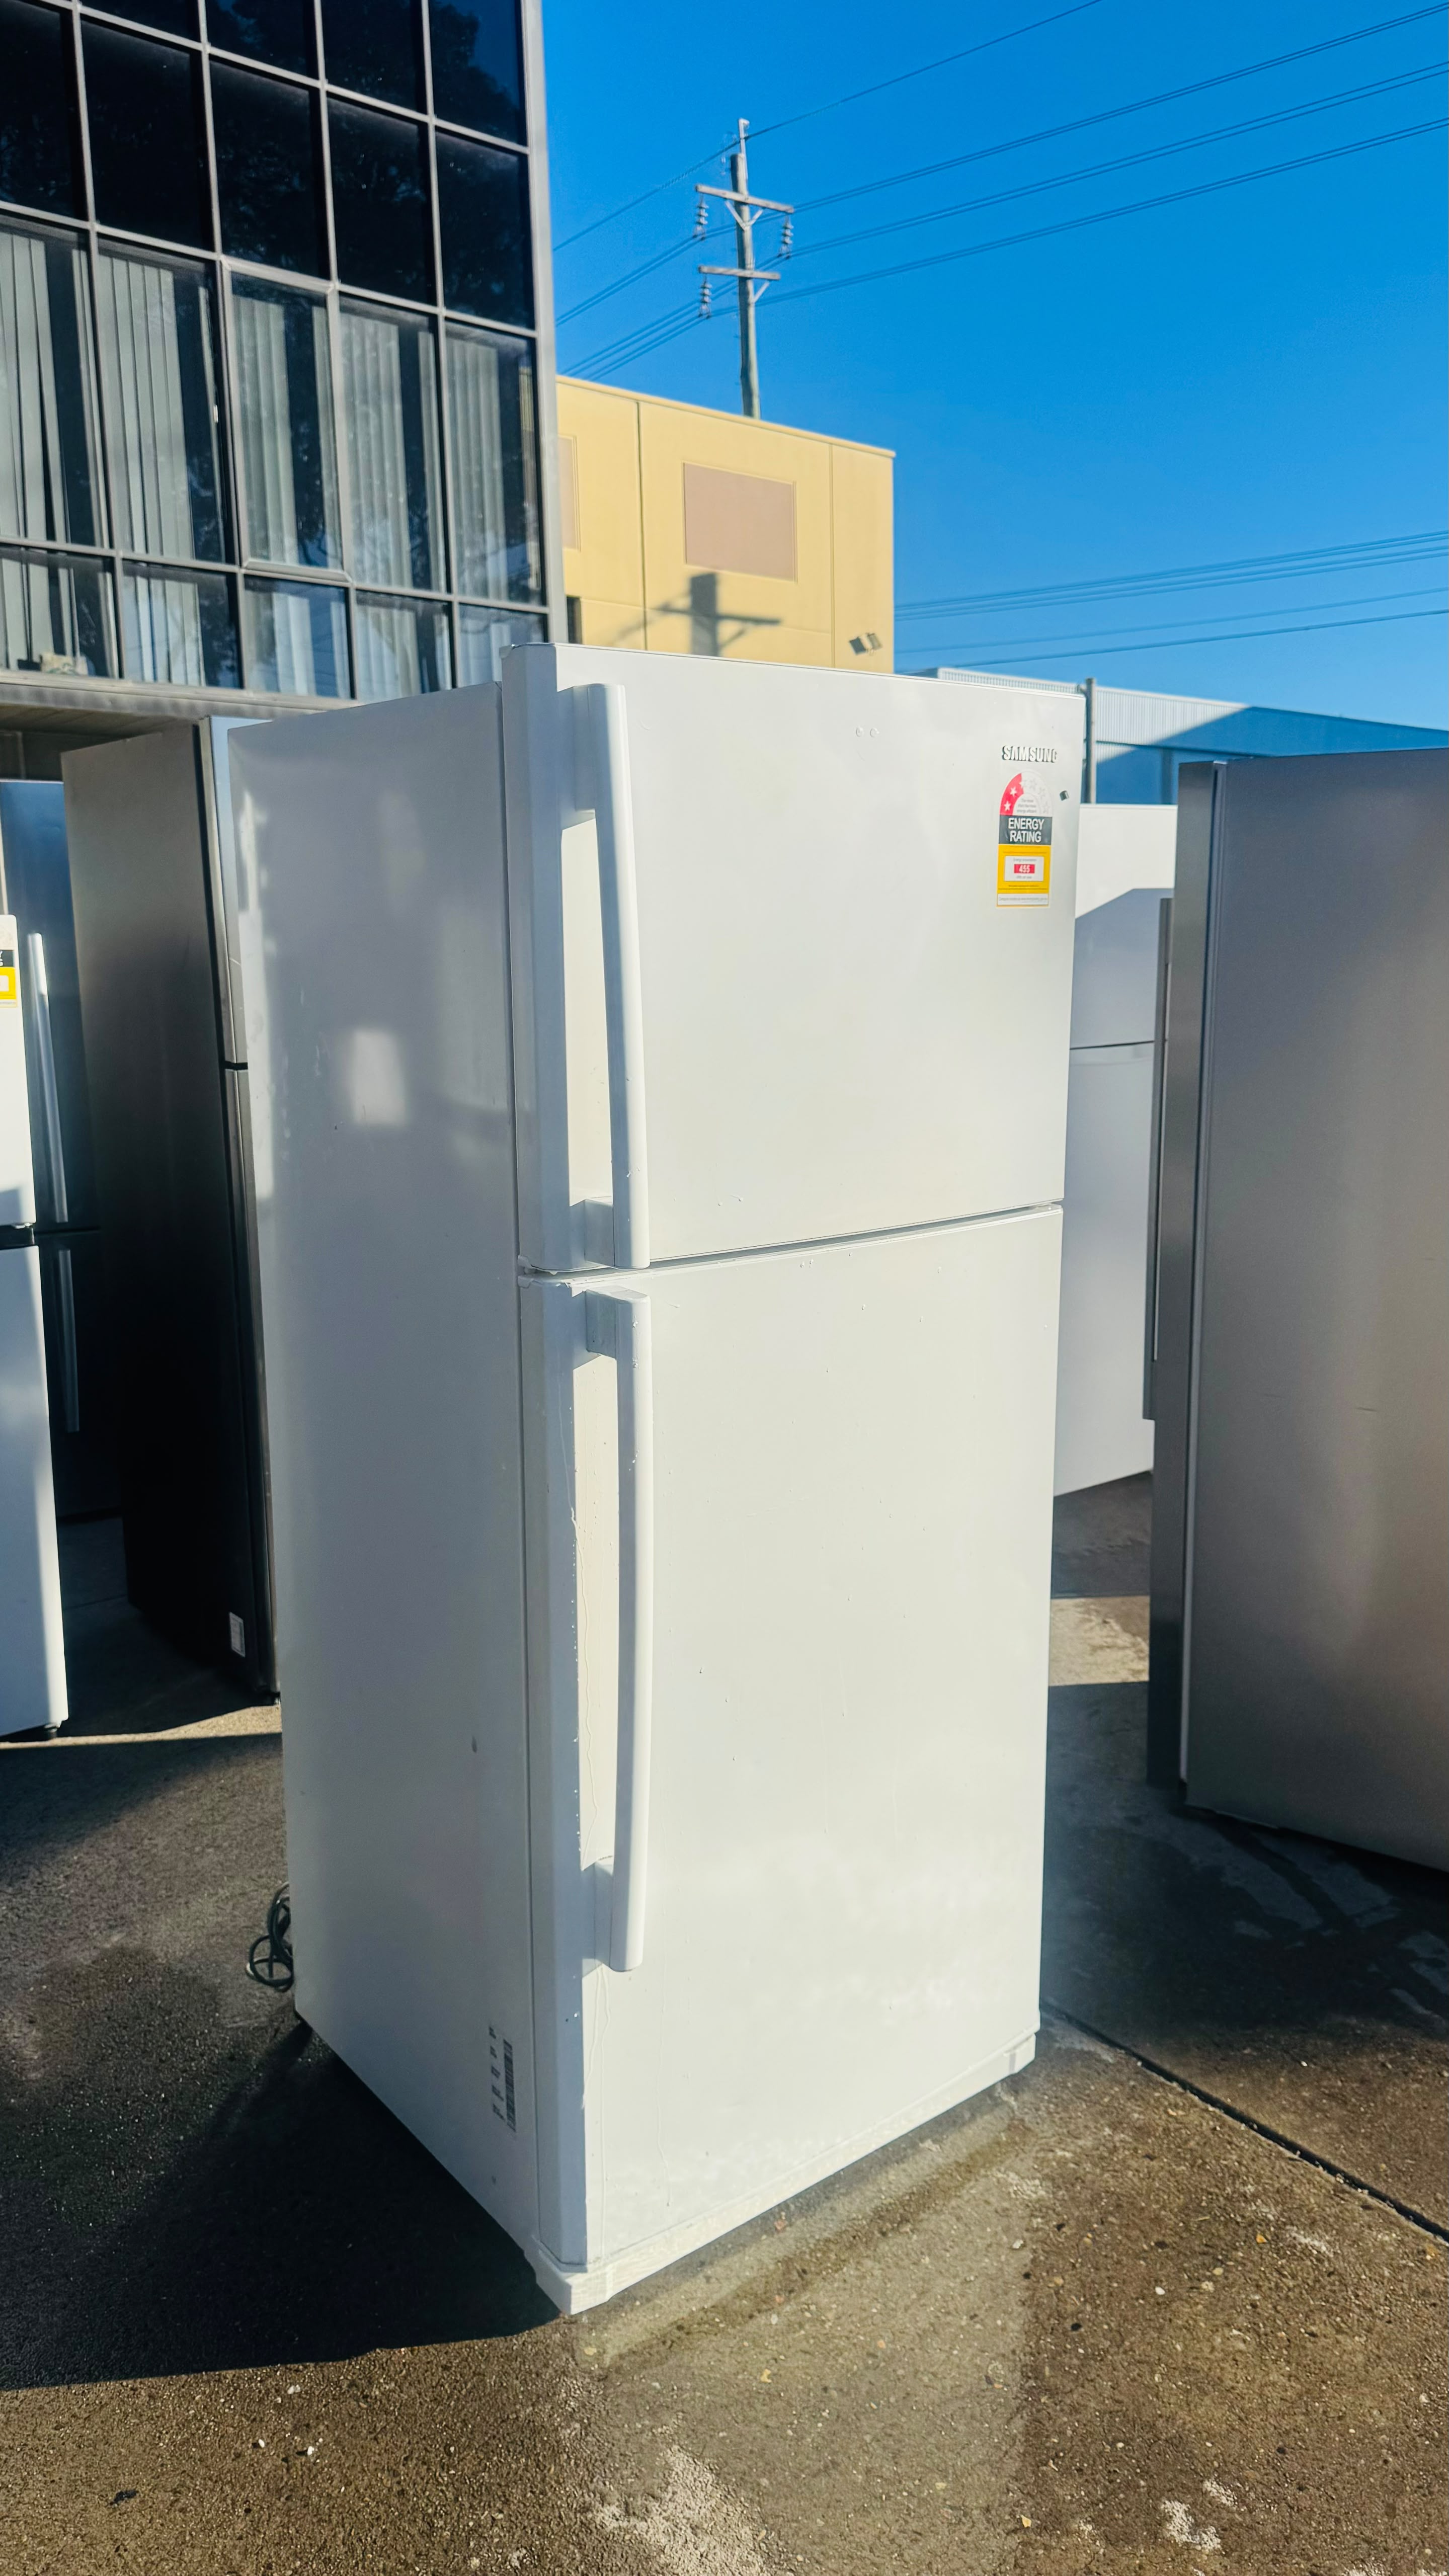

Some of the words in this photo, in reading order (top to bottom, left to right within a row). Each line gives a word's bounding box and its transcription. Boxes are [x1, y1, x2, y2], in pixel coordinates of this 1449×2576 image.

[1002, 745, 1058, 763] SAMSUNG
[1008, 817, 1044, 830] ENERGY
[1010, 830, 1041, 843] RATING
